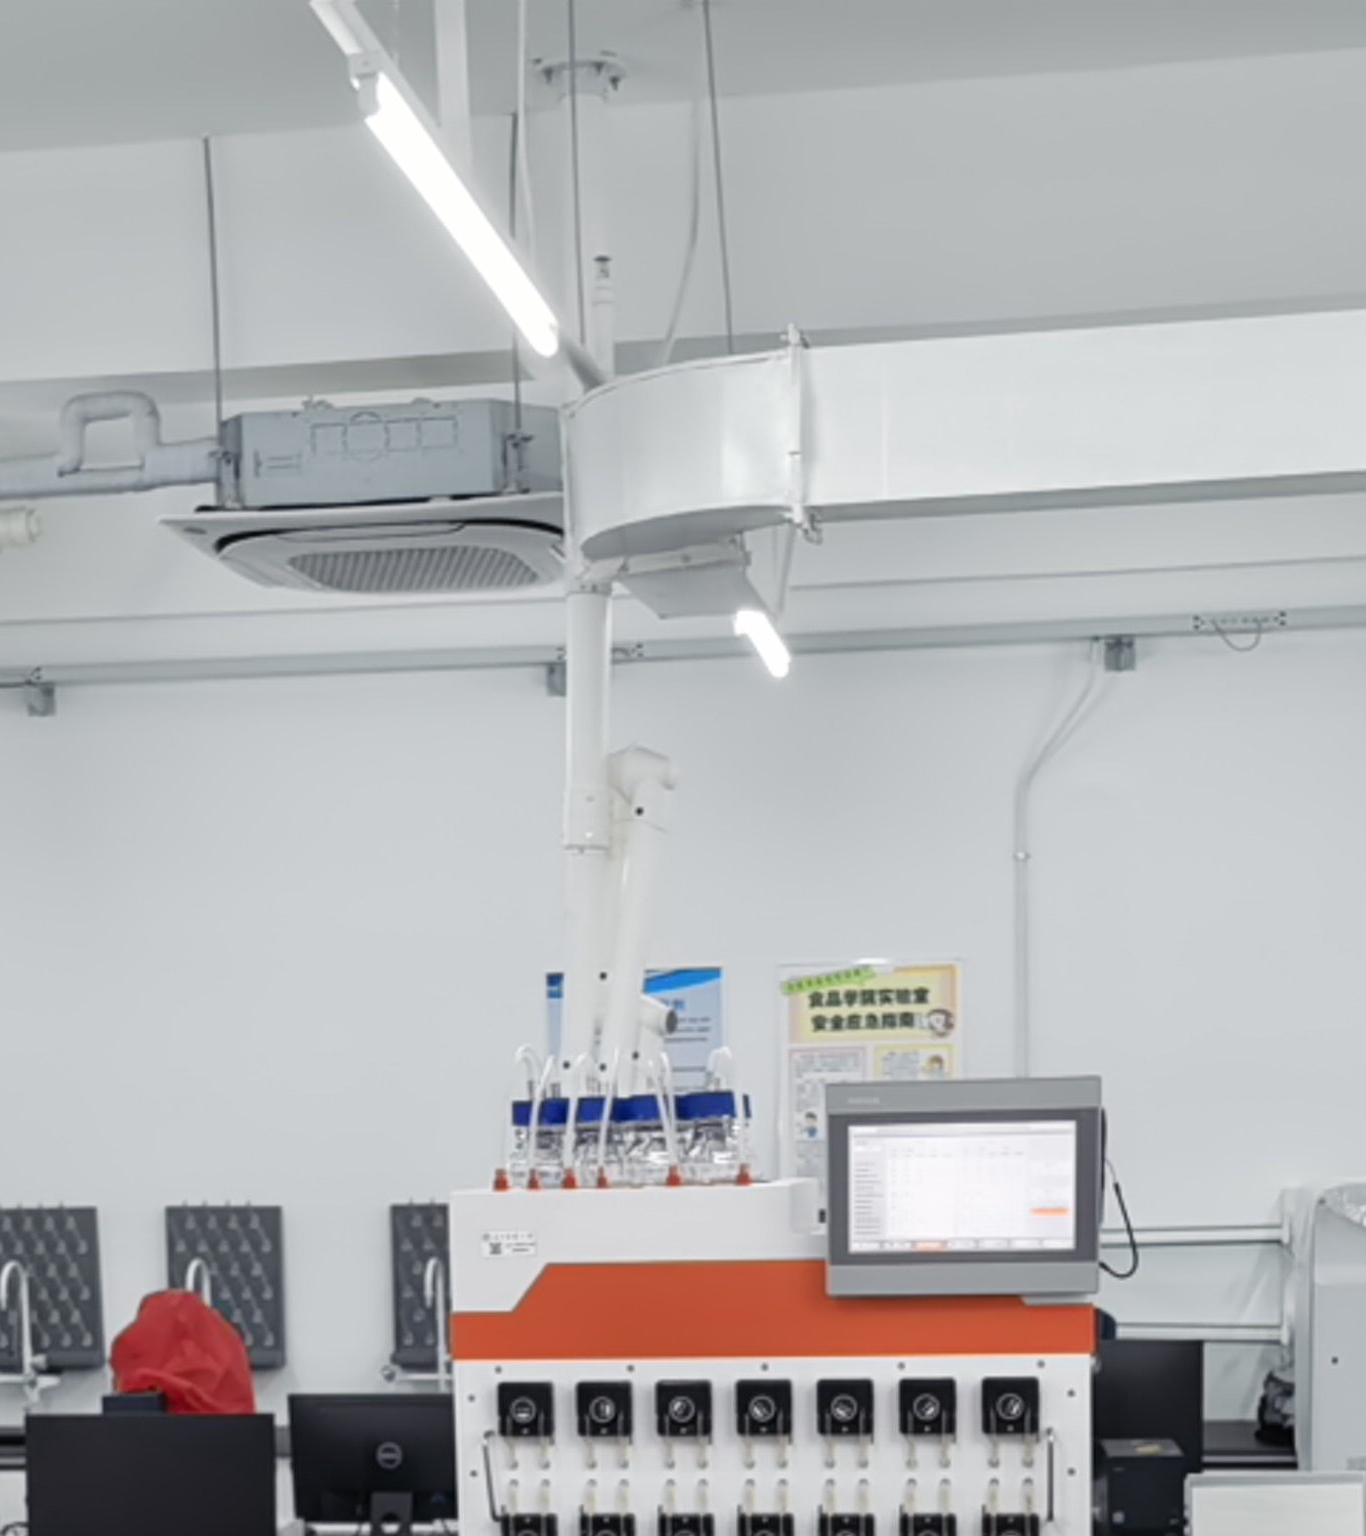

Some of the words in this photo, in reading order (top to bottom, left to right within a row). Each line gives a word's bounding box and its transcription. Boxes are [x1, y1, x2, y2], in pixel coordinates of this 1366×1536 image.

[809, 987, 929, 1009] 食品学院实验室
[812, 1012, 915, 1032] 安全应急指南
